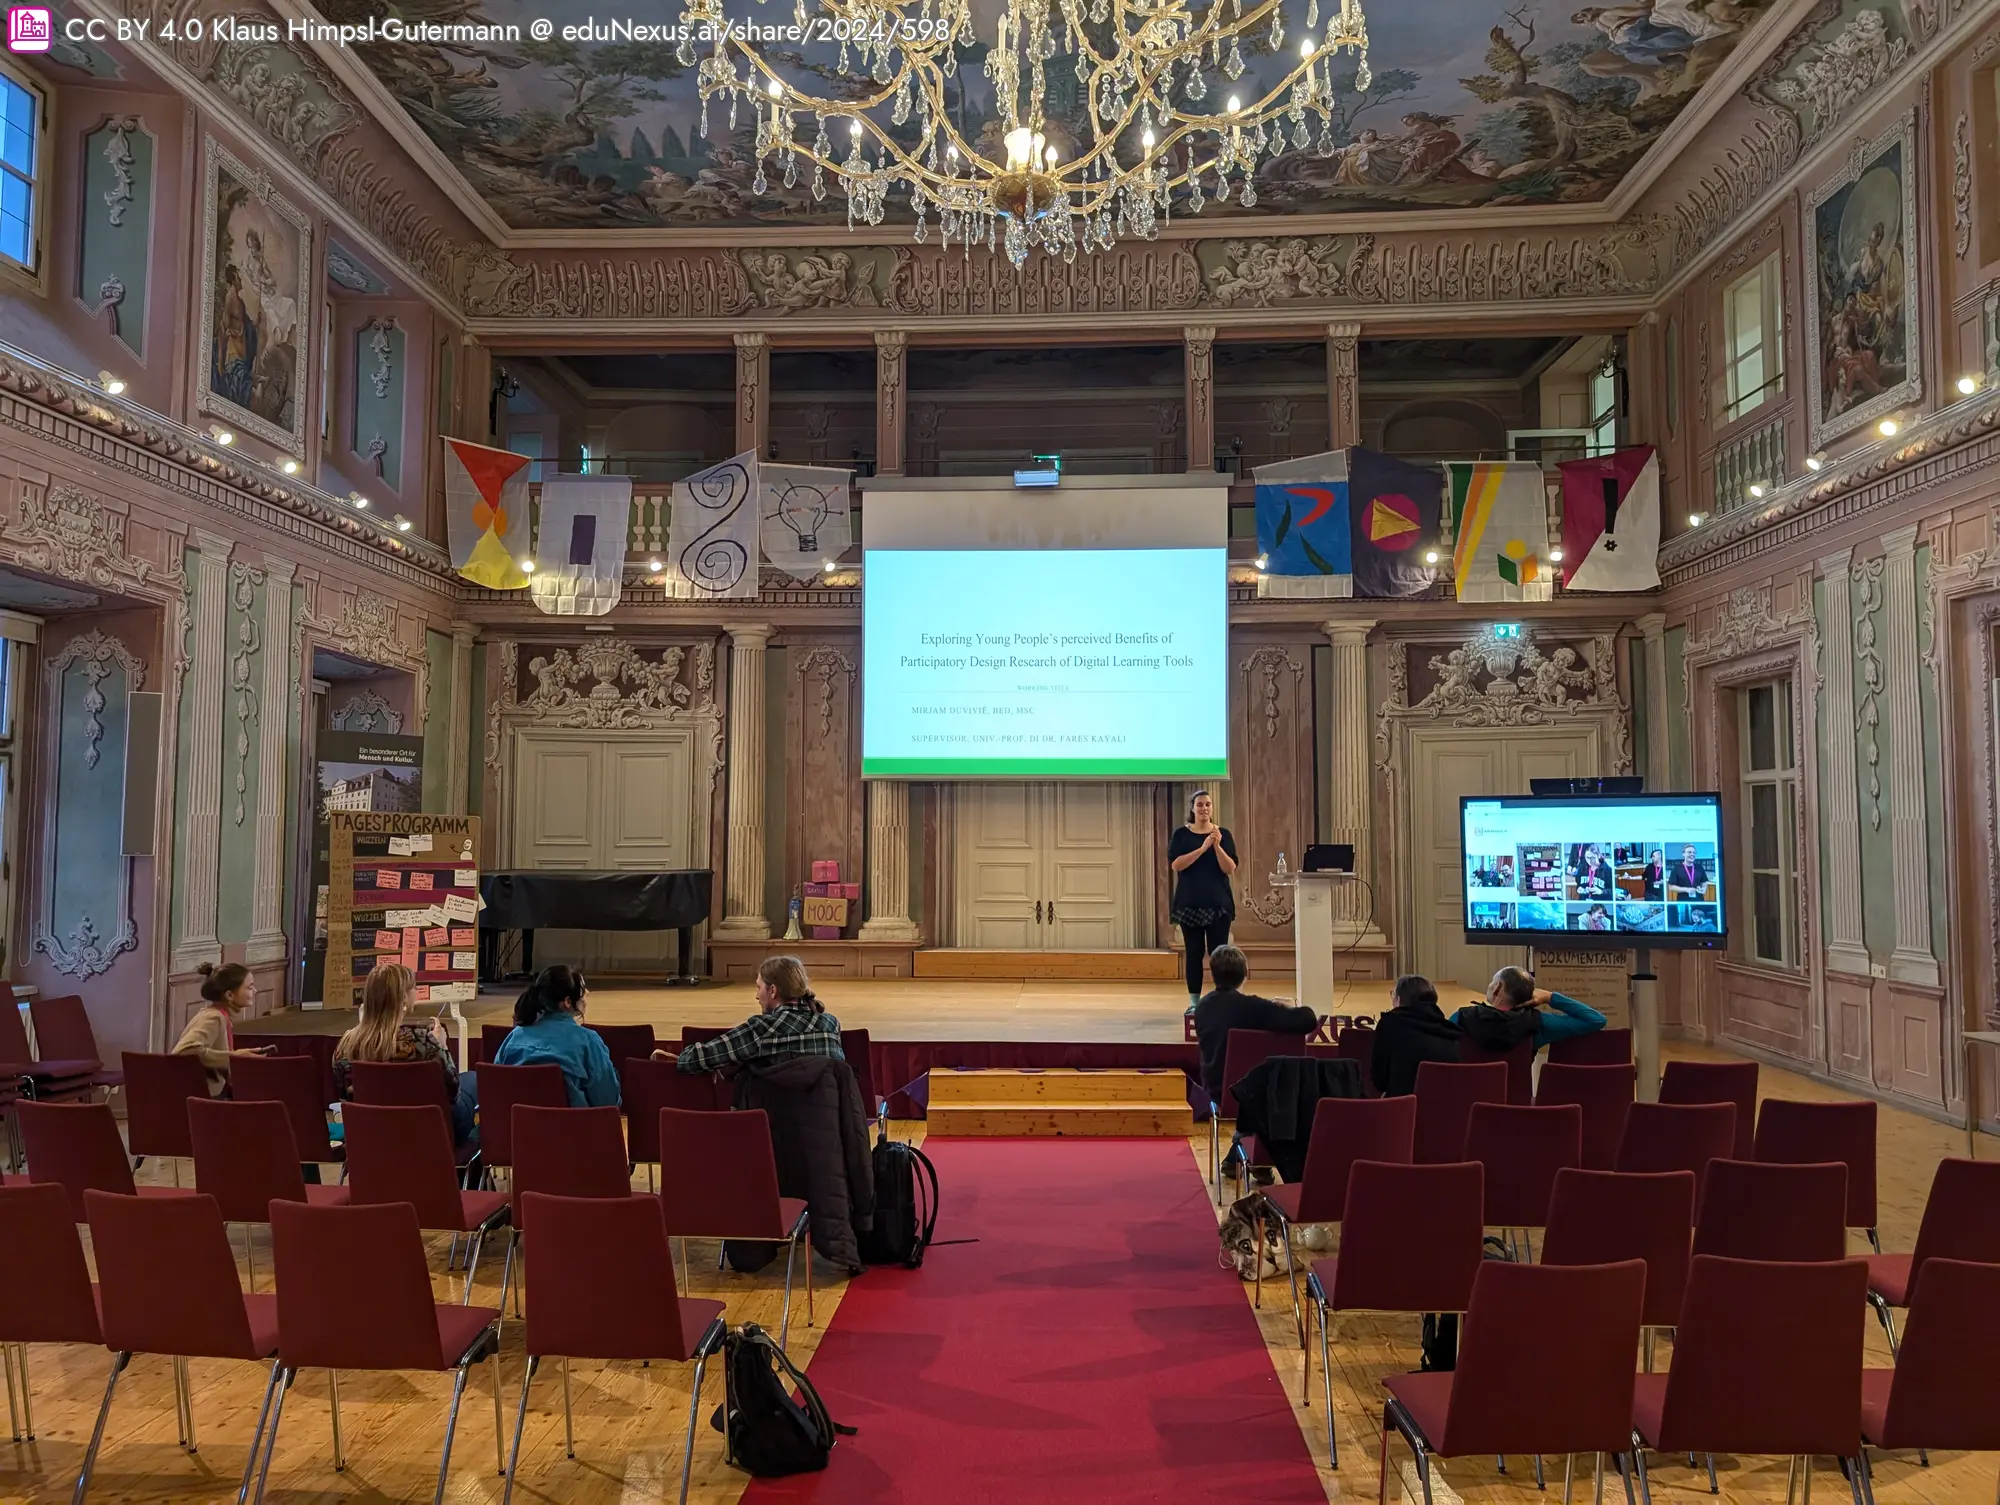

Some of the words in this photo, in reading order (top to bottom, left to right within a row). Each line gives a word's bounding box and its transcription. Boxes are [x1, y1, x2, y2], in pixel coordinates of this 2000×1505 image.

[921, 633, 972, 647] Exploring
[976, 633, 1011, 647] Young
[1061, 632, 1112, 647] perceived
[1115, 632, 1159, 644] Benefits
[1161, 632, 1174, 644] of
[900, 656, 966, 670] Participatory
[970, 656, 1006, 670] Design
[1009, 655, 1056, 667] Research
[1059, 656, 1073, 667] of
[1074, 656, 1109, 670] Digital
[1113, 655, 1160, 670] Learning
[1163, 655, 1194, 667] Tools
[332, 813, 470, 834] TAGESPROGRAMM
[808, 904, 843, 922] MOOC
